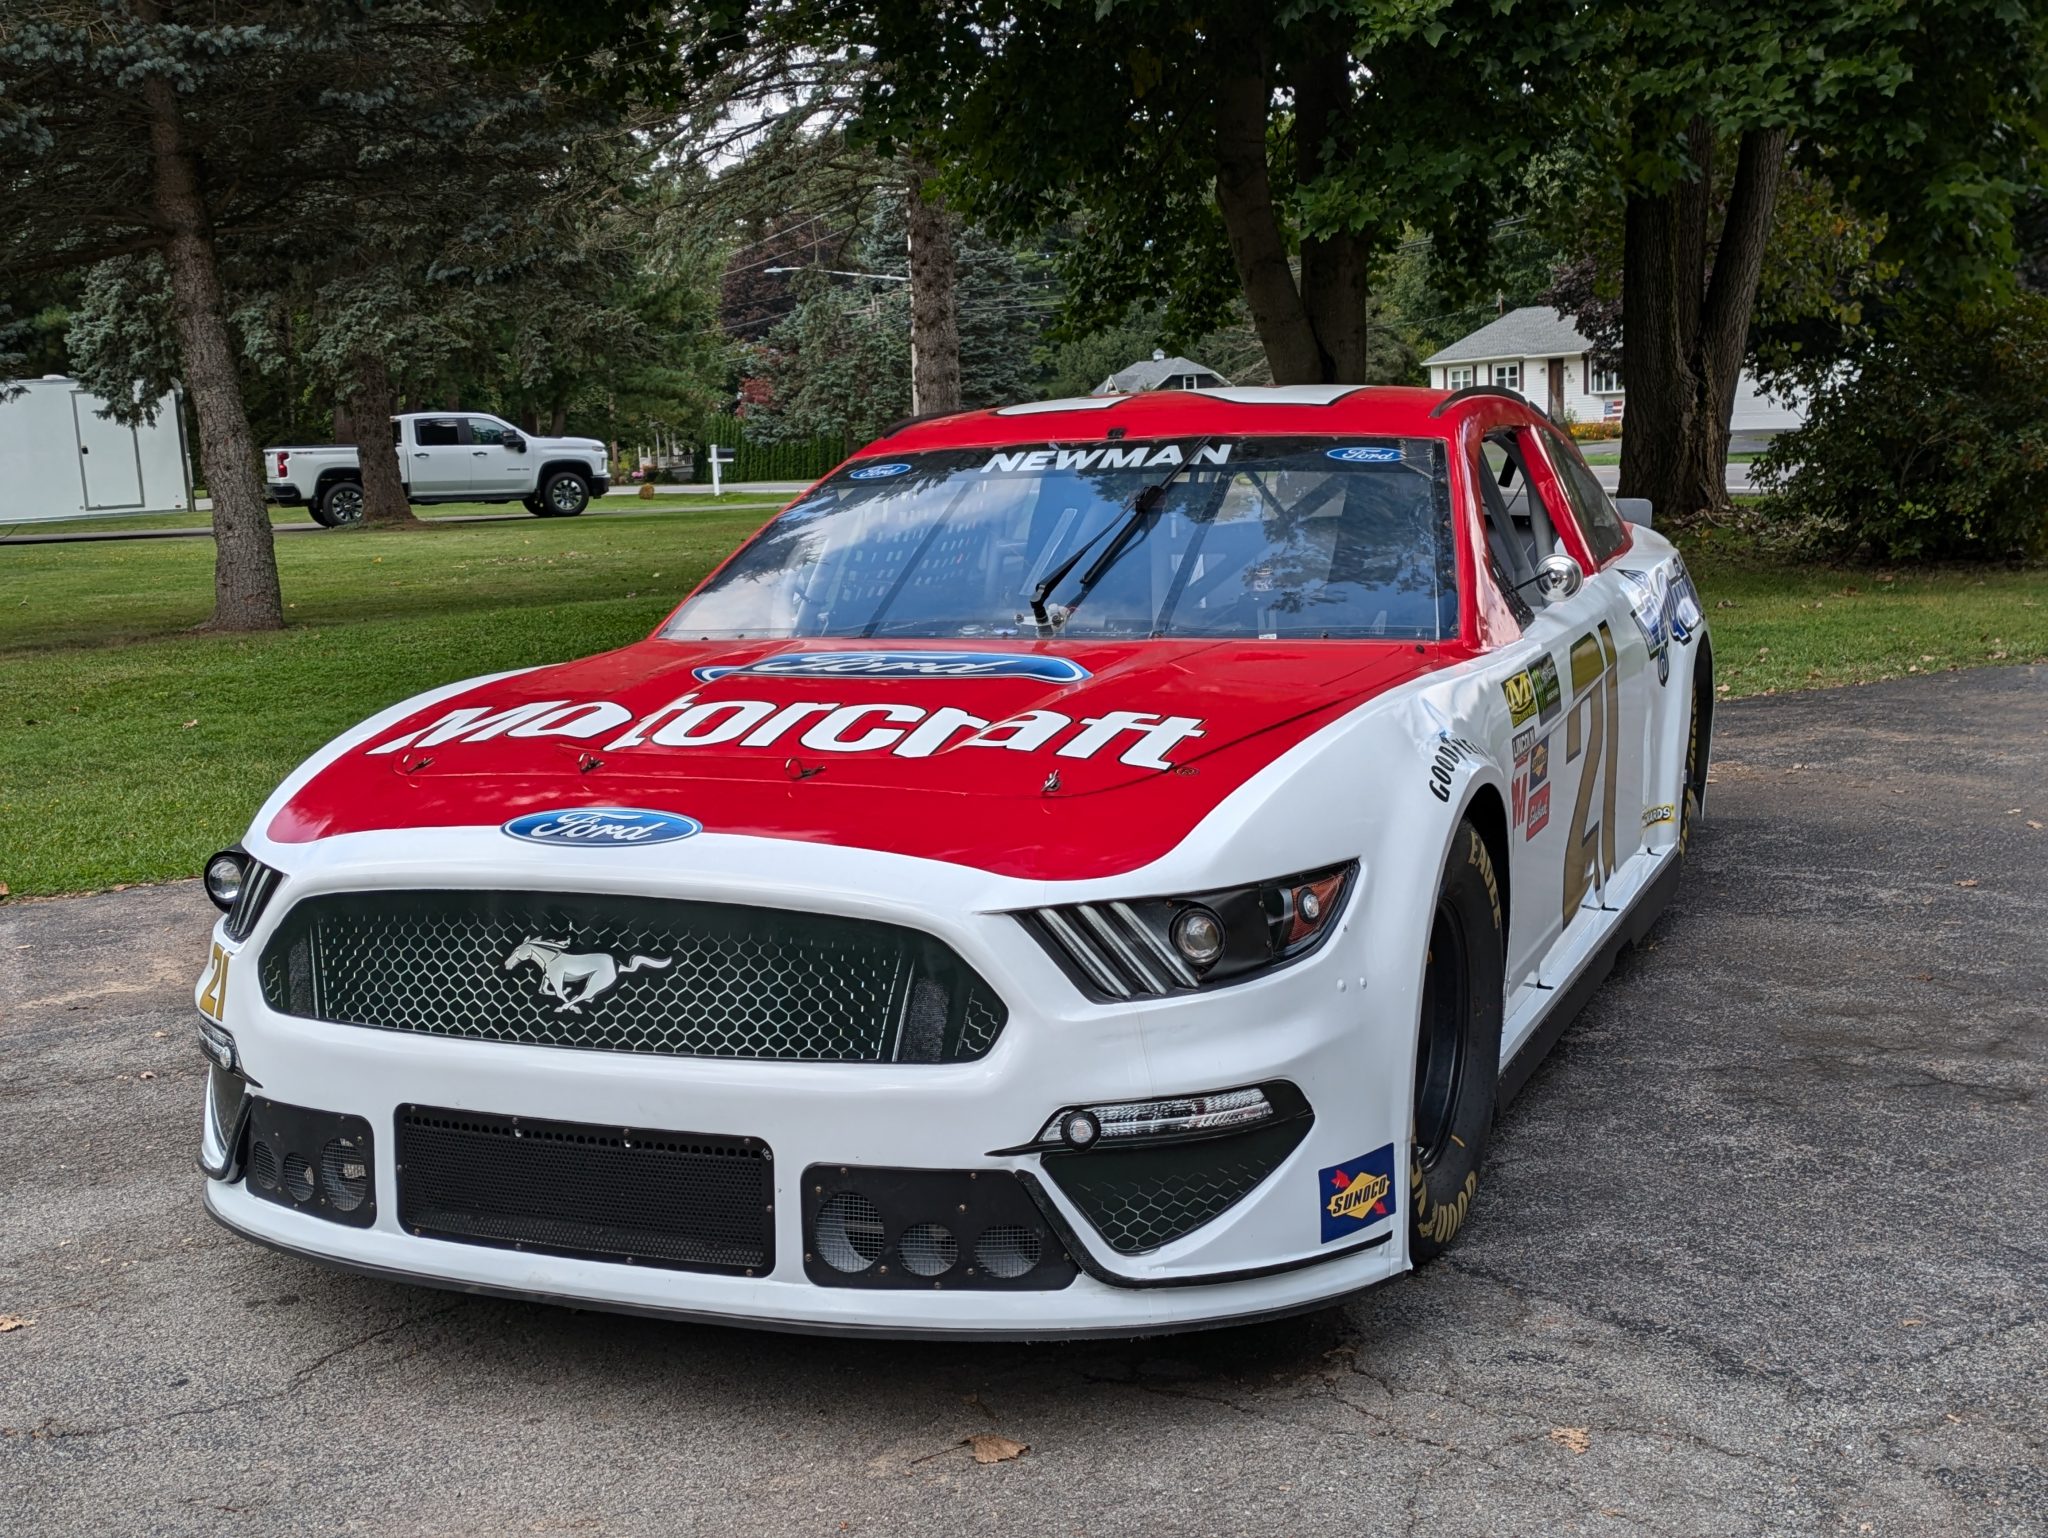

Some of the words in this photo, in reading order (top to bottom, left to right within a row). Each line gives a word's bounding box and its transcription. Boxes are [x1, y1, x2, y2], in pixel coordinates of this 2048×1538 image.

[980, 444, 1232, 473] NEWMAN
[1342, 449, 1394, 460] Ford
[859, 465, 901, 477] Ford
[752, 655, 1022, 674] Ford
[364, 699, 1207, 772] Motorcraft
[1561, 619, 1618, 932] 21
[530, 811, 667, 841] Ford
[199, 941, 234, 1022] 21
[1332, 1176, 1388, 1214] SUNOCO
